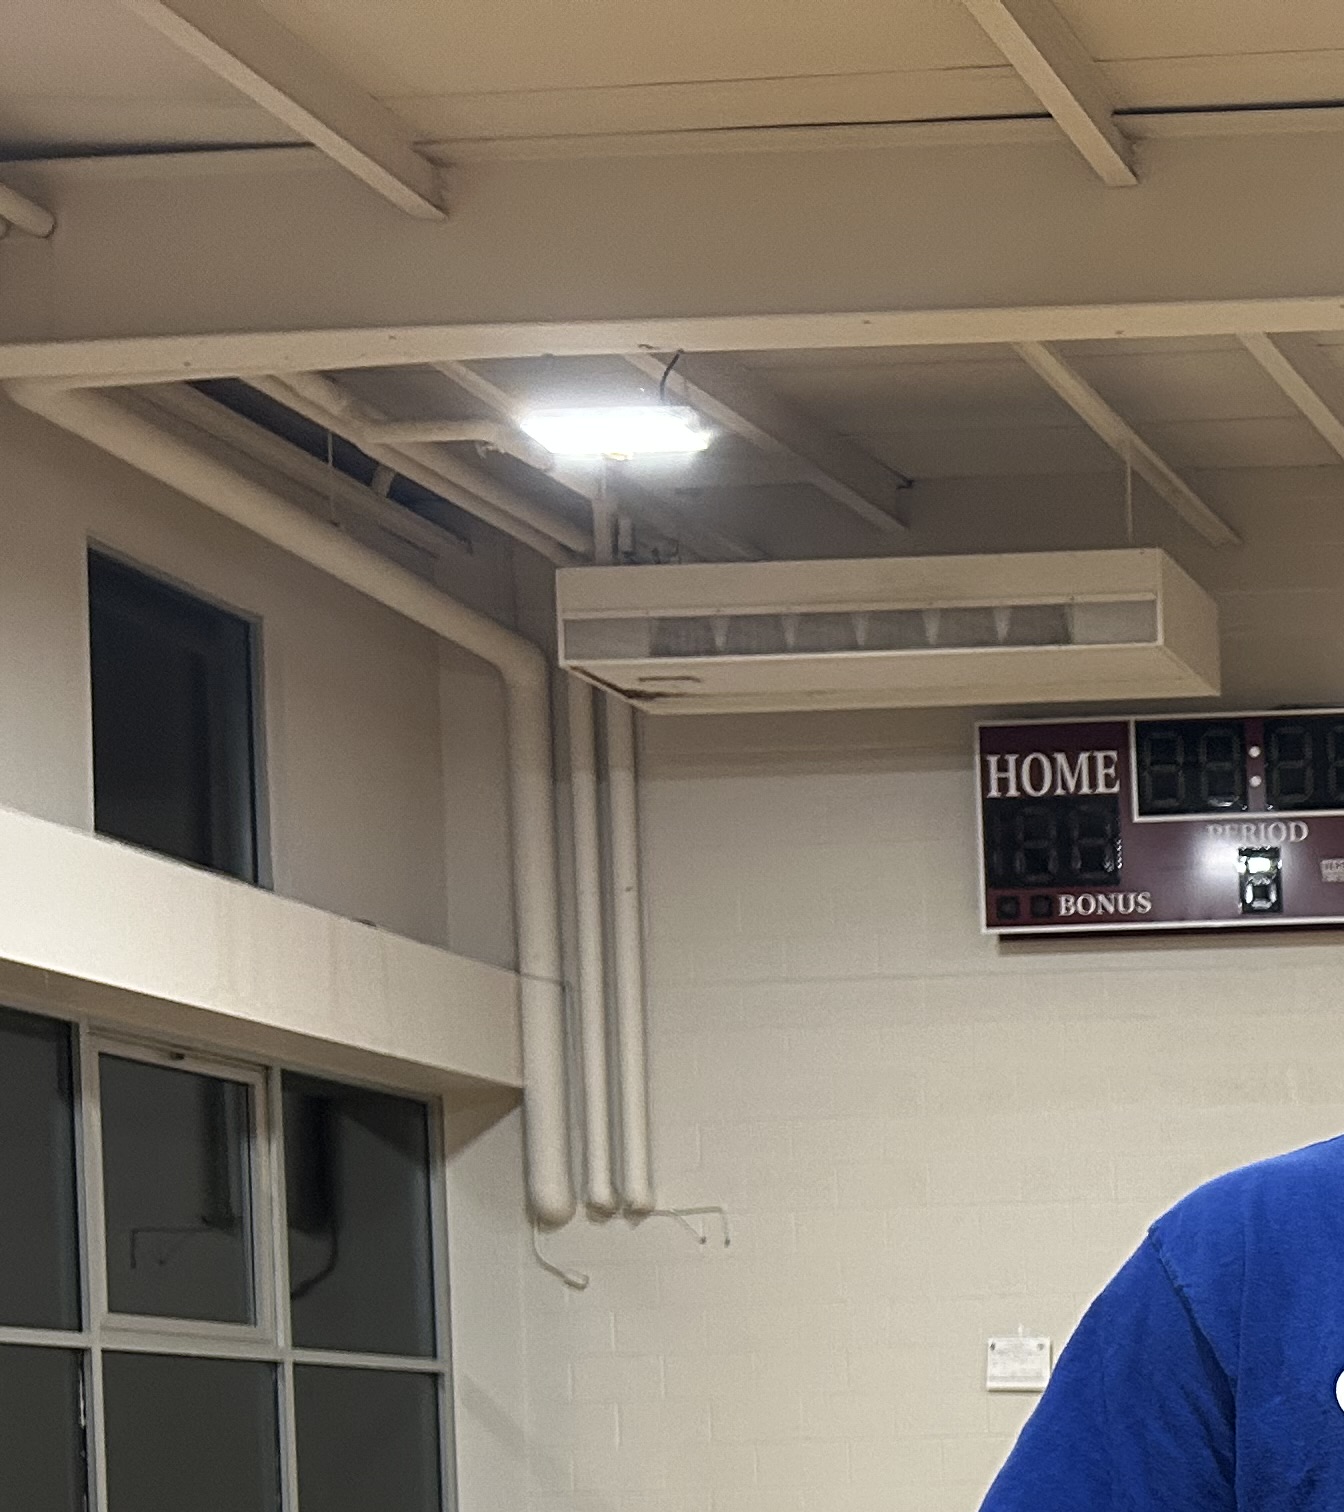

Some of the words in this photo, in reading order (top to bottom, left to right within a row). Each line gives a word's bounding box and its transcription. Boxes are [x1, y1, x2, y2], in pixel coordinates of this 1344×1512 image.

[986, 750, 1120, 798] HOME
[1207, 821, 1309, 844] PERIOD
[1058, 891, 1152, 916] BONUS
